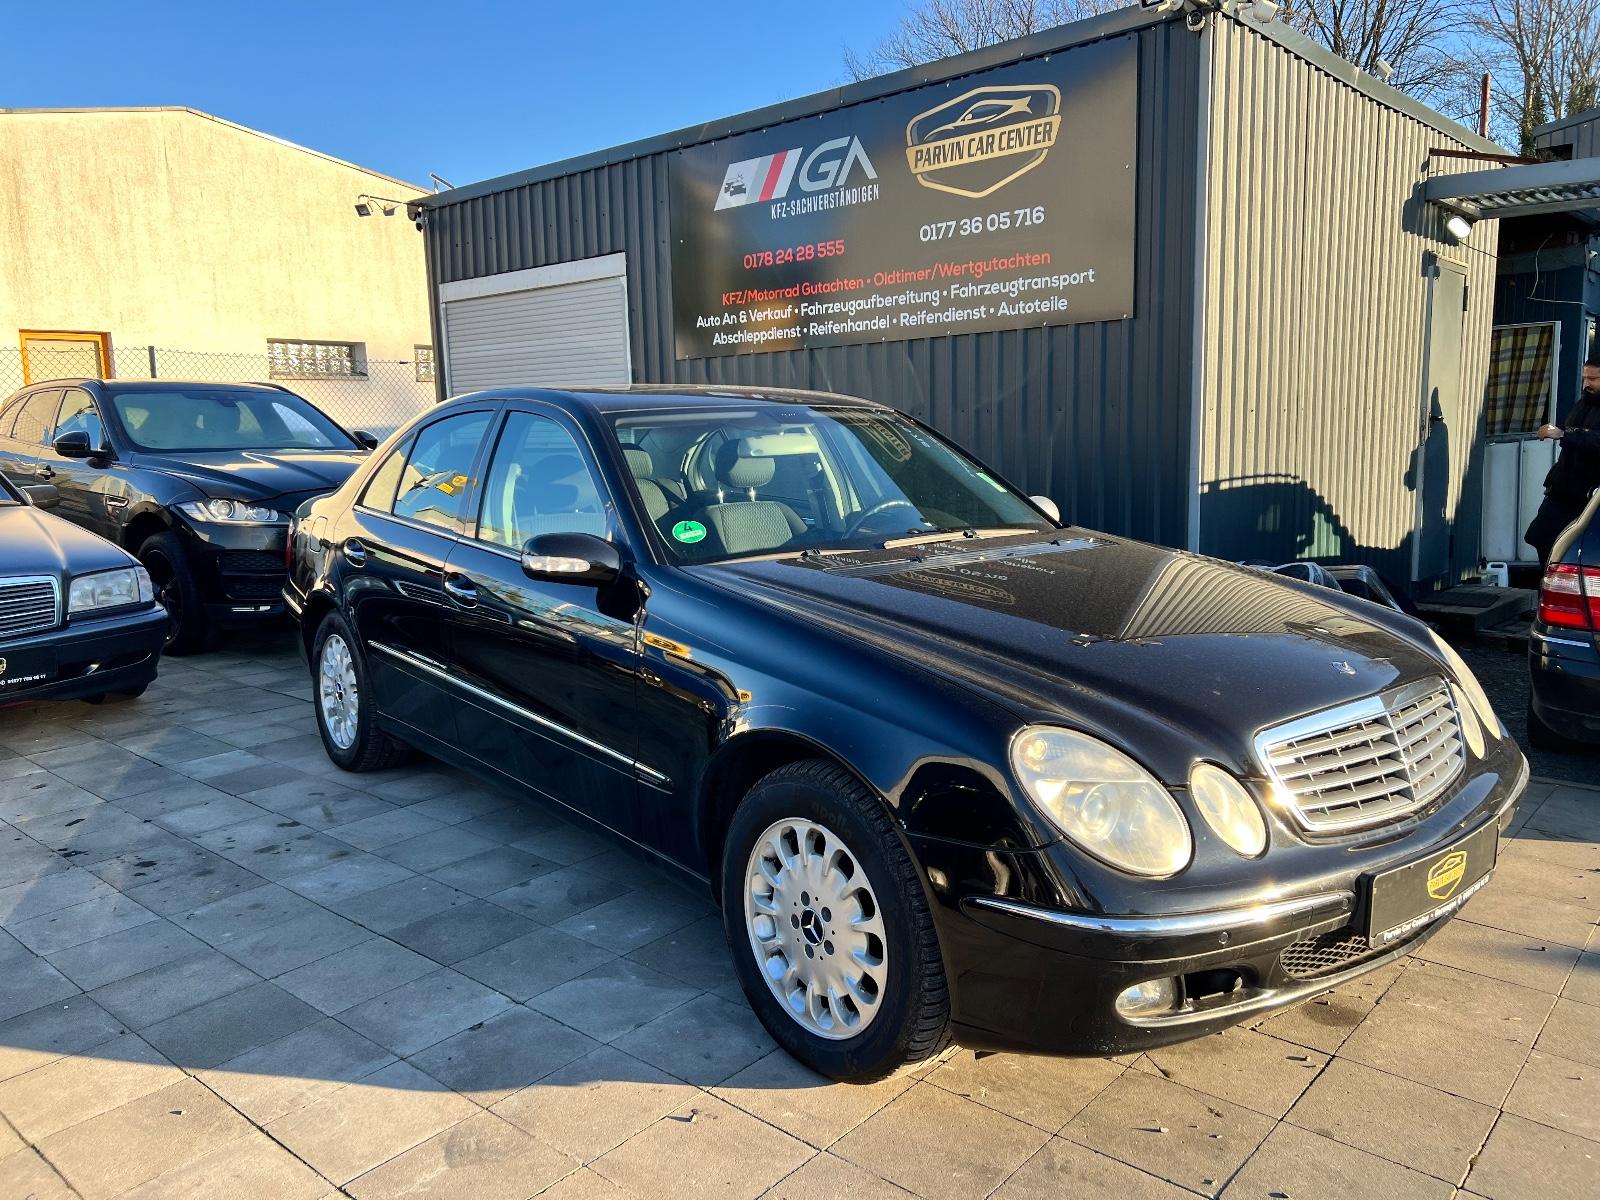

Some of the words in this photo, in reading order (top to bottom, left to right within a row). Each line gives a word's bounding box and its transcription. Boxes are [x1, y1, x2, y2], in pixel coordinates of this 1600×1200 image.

[914, 140, 964, 169] PARVIN
[967, 133, 995, 158] CAR
[998, 121, 1053, 152] CENTER
[771, 183, 879, 220] KFZ-SACHVERSTÄNDIGEN
[919, 220, 957, 242] 0177
[959, 216, 983, 236] 36
[986, 211, 1011, 231] 05
[1014, 205, 1045, 227] 716
[722, 284, 800, 306] KFZ/Motorrad
[801, 276, 864, 296] Gutachten
[873, 251, 1051, 287] Oldtimer/Wertgutachten
[743, 251, 773, 270] 0178
[775, 247, 793, 264] 24
[796, 244, 814, 262] 28
[817, 239, 845, 258] 555
[696, 315, 721, 328] Auto
[722, 312, 737, 326] An
[739, 310, 748, 323] &
[749, 304, 793, 322] Verkauf
[800, 288, 940, 317] Fahrzeugaufbereitung
[950, 268, 1095, 299] Fahrzeugtransport
[712, 325, 802, 346] Abschleppdienst
[809, 314, 890, 337] Reifenhandel
[900, 304, 987, 327] Reifendienst
[997, 295, 1068, 317] Autoteile
